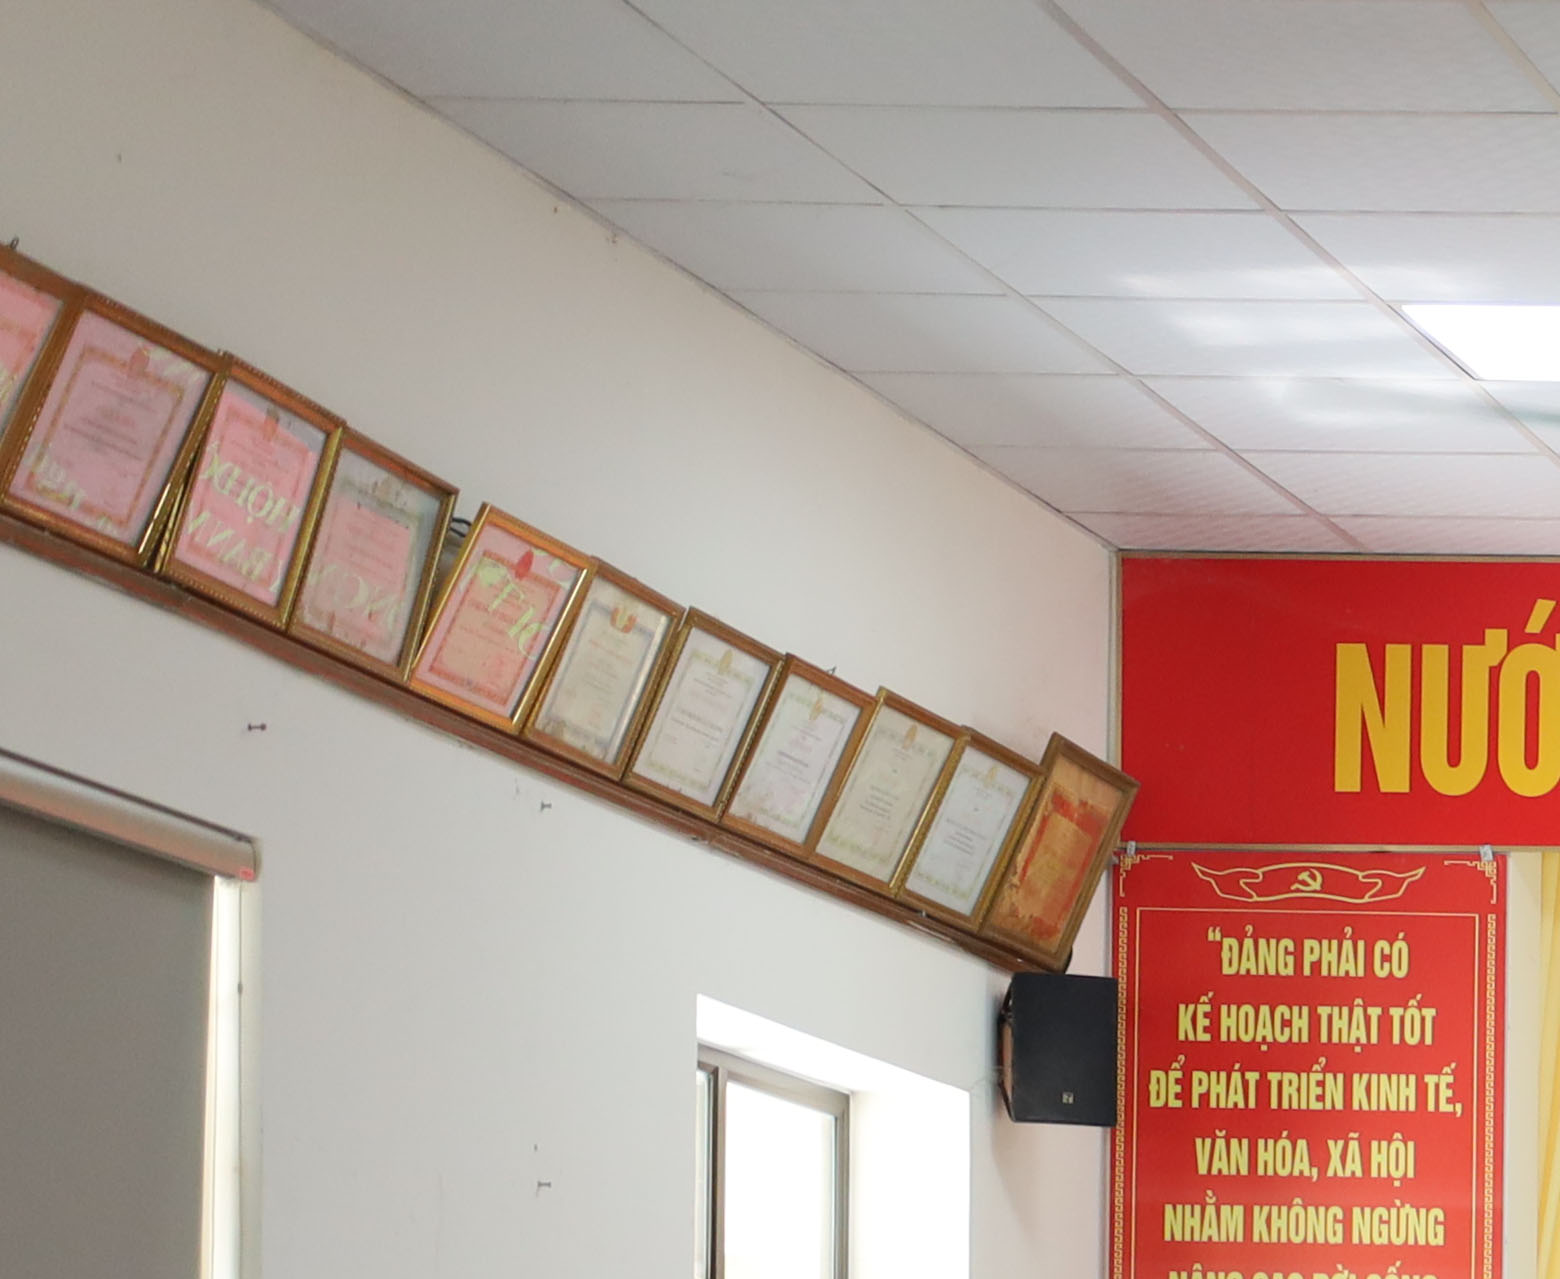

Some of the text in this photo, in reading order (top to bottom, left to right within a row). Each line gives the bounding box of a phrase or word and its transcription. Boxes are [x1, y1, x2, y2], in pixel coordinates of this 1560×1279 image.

[1208, 925, 1408, 978] “ĐẢNG PHẢI CÓ
[1179, 992, 1436, 1052] KẾ HOẠCH THẬT TỐT
[1150, 1055, 1462, 1117] ĐỂ PHÁT TRIỂN KINH TẾ,
[1196, 1130, 1414, 1187] VĂN HÓA, XÃ HỘI
